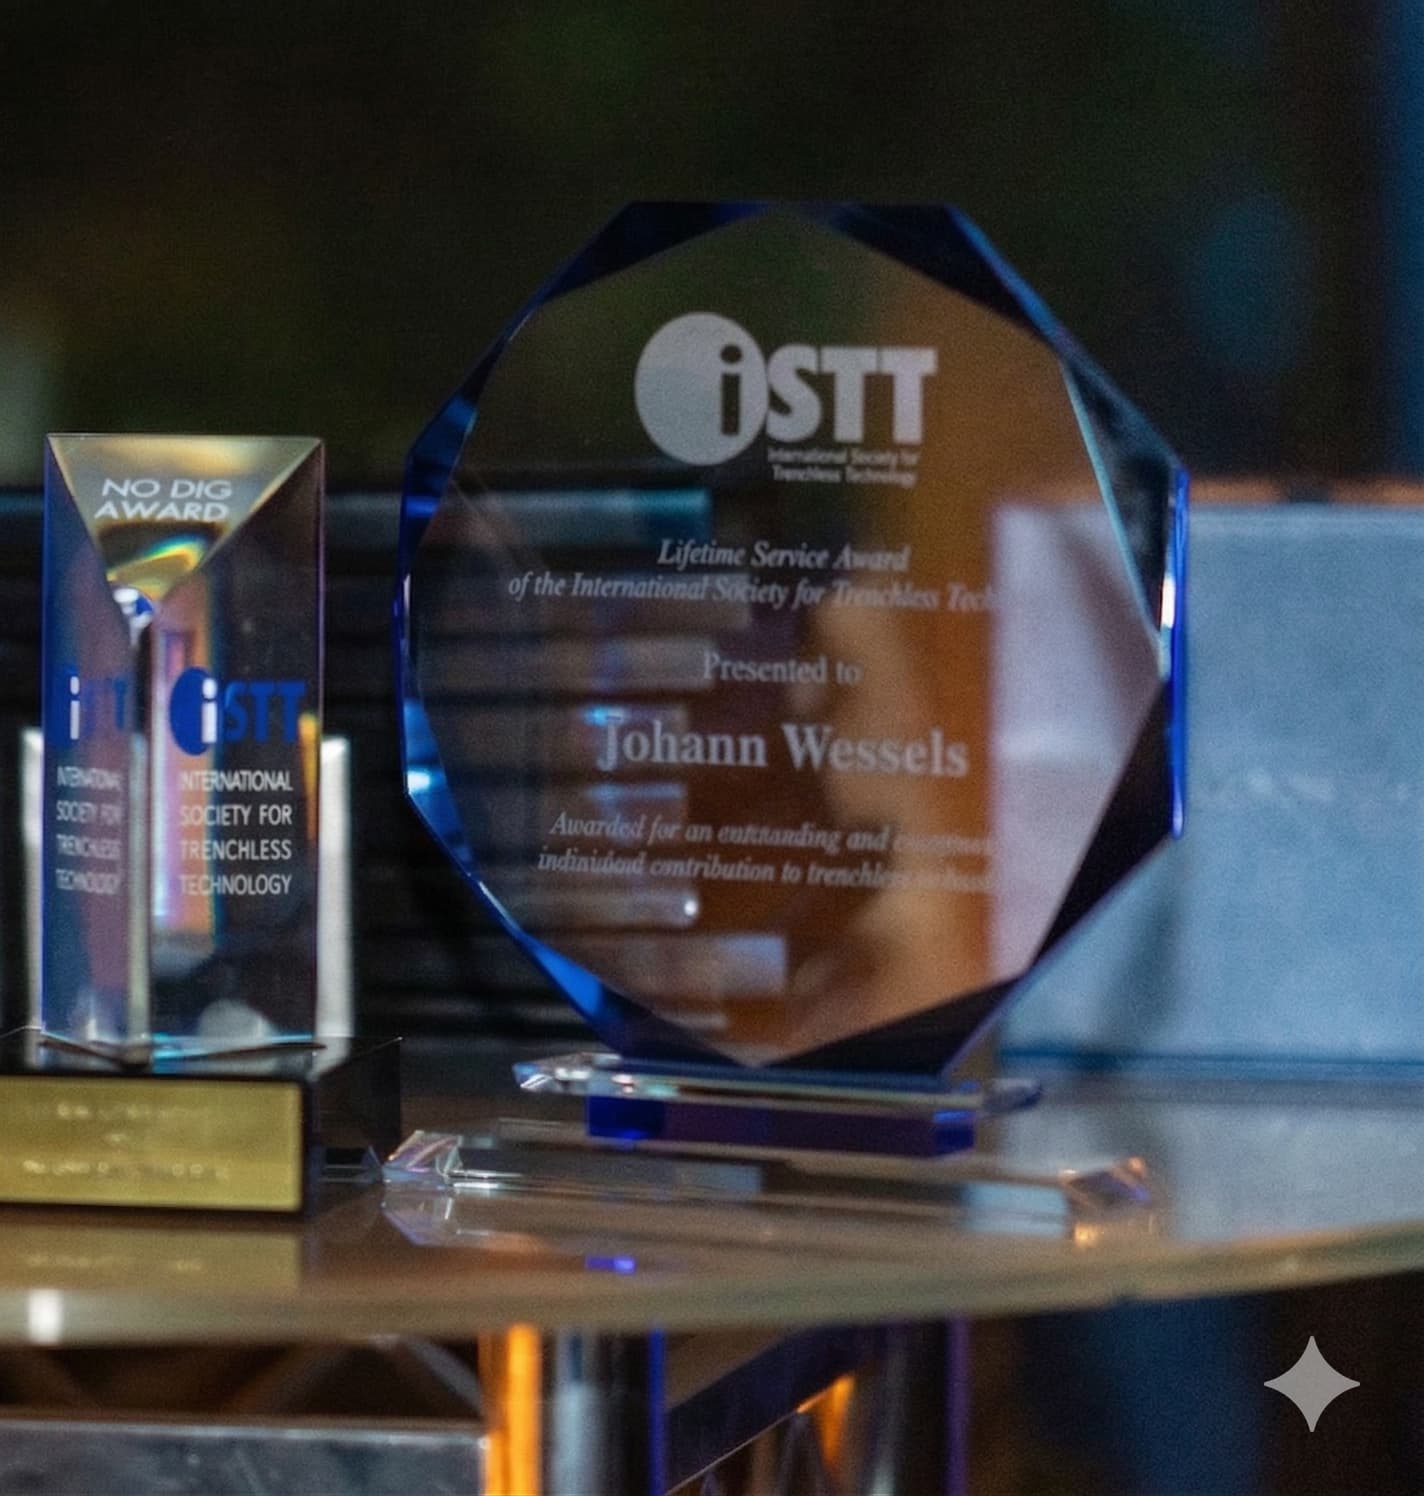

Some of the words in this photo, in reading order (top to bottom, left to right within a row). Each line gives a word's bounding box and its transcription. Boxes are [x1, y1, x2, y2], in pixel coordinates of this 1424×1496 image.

[101, 479, 160, 498] NO
[170, 480, 232, 500] DIG
[94, 501, 229, 520] AWARD
[657, 539, 745, 571] Lifetime
[751, 540, 830, 569] Service
[833, 544, 912, 572] Award
[508, 571, 533, 601] of
[534, 571, 568, 596] the
[571, 572, 709, 600] International
[712, 574, 789, 609] Society
[791, 578, 826, 611] for
[703, 651, 827, 684] Presented
[836, 660, 862, 685] to
[597, 714, 768, 772] Johann
[782, 723, 968, 777] Wessels
[180, 769, 293, 791] INTERNATIONAL
[180, 804, 250, 825] SOCIETY
[259, 805, 292, 826] FOR
[549, 811, 646, 840] Awarded
[647, 814, 681, 845] for
[685, 822, 712, 842] an
[846, 825, 891, 851] and
[180, 838, 292, 860] TRENCHLESS
[650, 853, 774, 881] contribution
[781, 861, 800, 884] to
[180, 873, 292, 896] TECHNOLOGY
